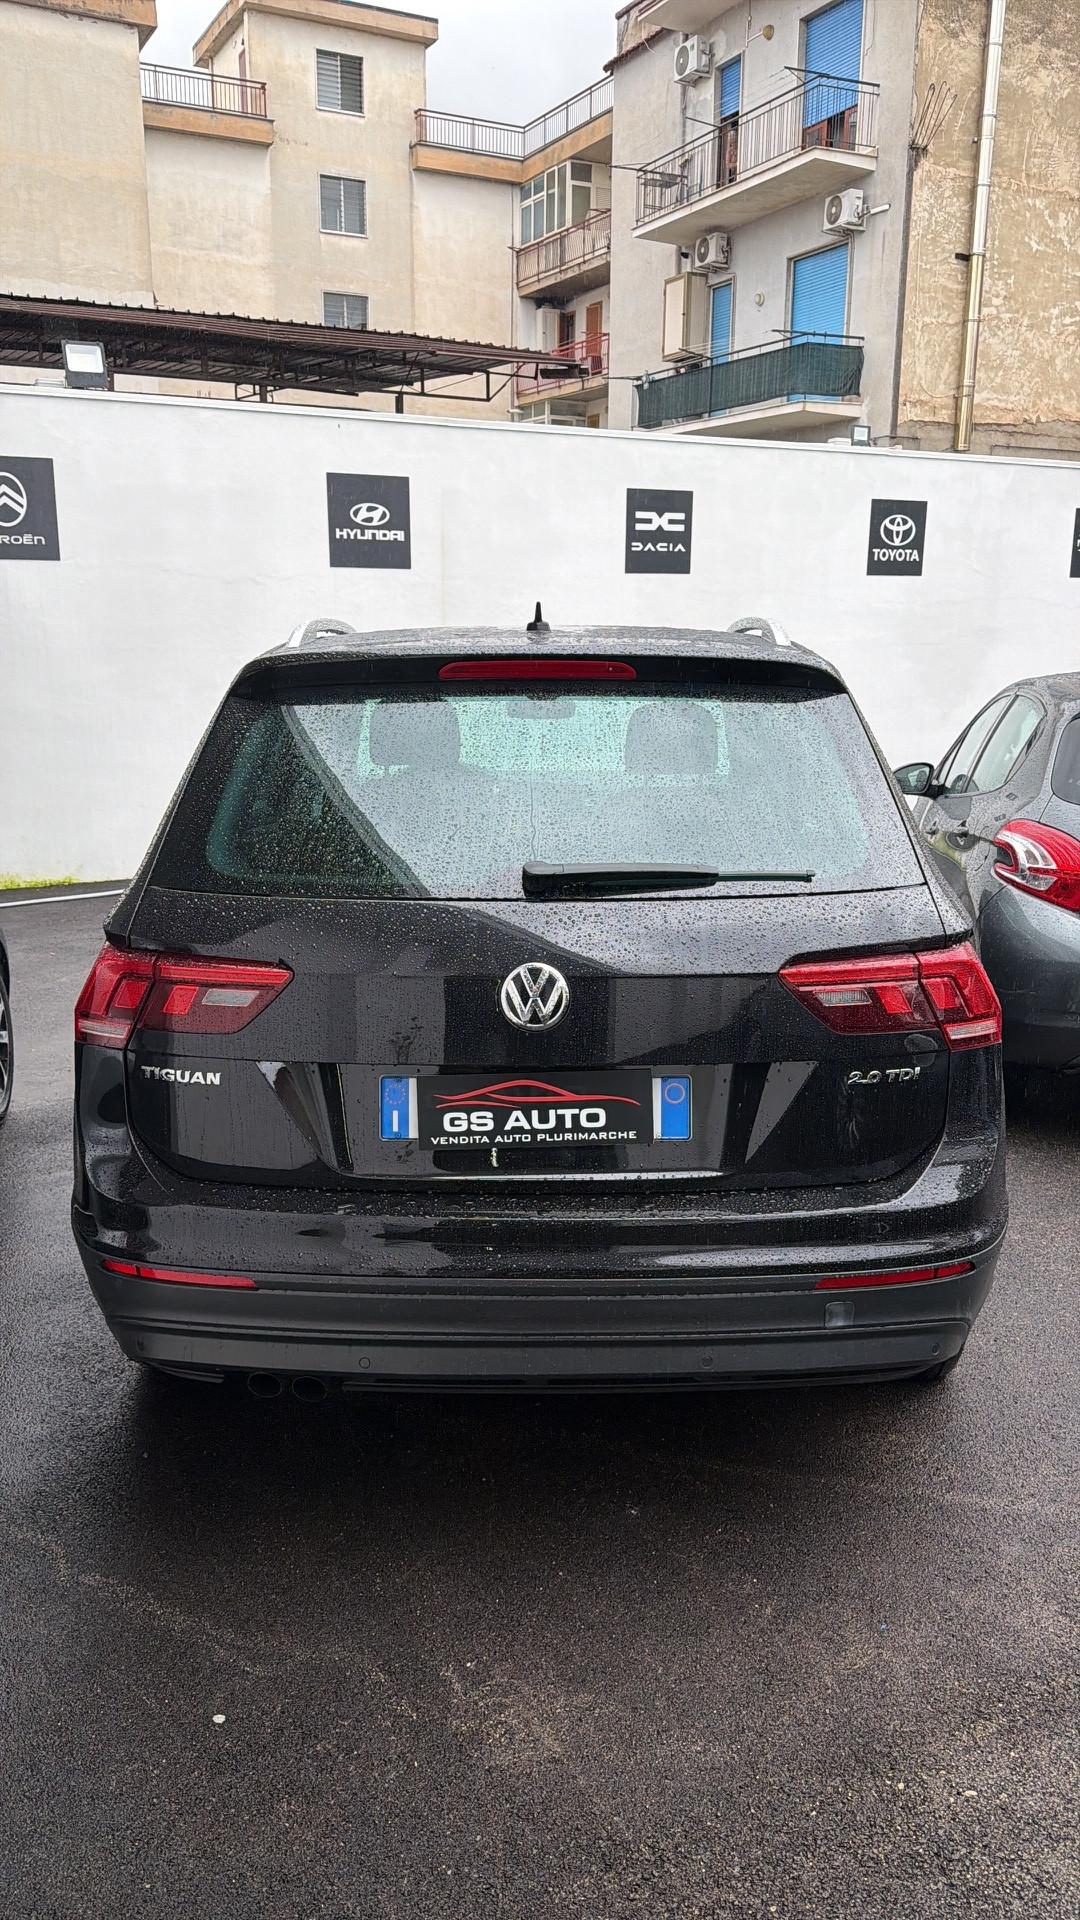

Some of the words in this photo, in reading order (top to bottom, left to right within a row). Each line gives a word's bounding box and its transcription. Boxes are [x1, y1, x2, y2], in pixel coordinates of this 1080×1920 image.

[335, 528, 405, 542] HYUNDAI
[631, 542, 686, 552] DACIA
[872, 548, 920, 562] TOYOTA
[141, 1065, 222, 1086] TIGUAN
[885, 1066, 921, 1083] TDI
[443, 1111, 495, 1132] GS
[503, 1108, 607, 1131] AUTO
[430, 1135, 490, 1145] VENDITA
[494, 1134, 532, 1143] AUTO
[537, 1131, 638, 1142] PLURIMARCHE
